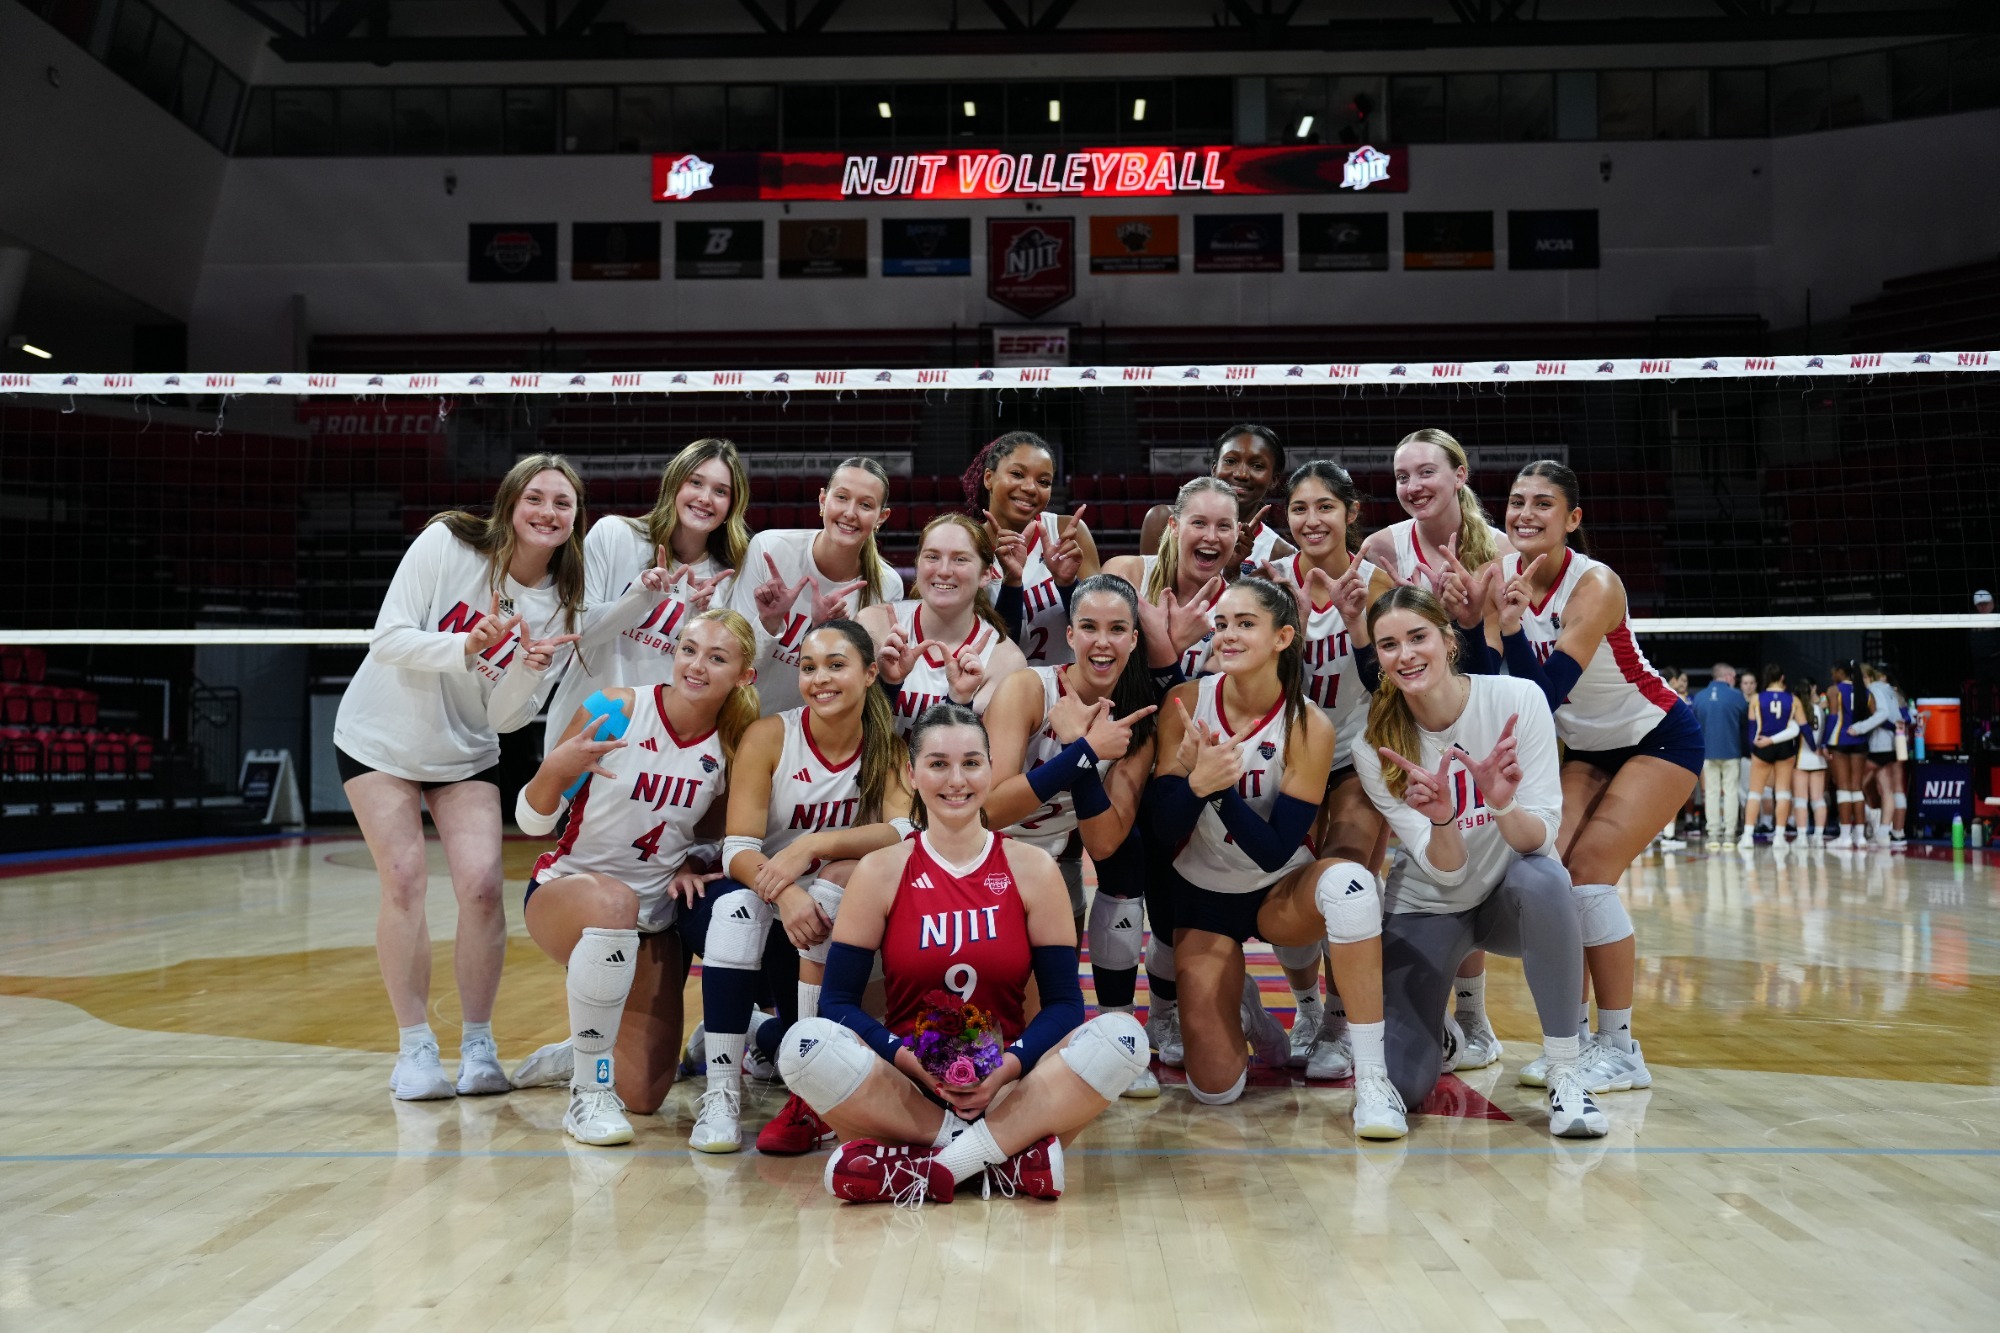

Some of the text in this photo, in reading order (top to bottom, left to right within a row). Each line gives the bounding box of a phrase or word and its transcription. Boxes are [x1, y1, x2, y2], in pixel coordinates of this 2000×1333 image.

[841, 152, 1225, 196] NJIT VOLLEYBALL
[1344, 160, 1389, 184] NJIT
[1008, 244, 1057, 278] NJIT
[1535, 238, 1574, 252] NCAA
[999, 336, 1066, 354] ESPN
[1, 352, 1989, 389] NJIT NJIT NJIT NJIT NJIT NJIT NJIT NJIT NJIT NJIT NJIT NJIT NJIT NJIT NJIT NJIT NJIT NJIT NJIT NJIT
[1023, 577, 1057, 625] JIT
[1026, 626, 1049, 661] 2
[1309, 673, 1341, 708] 11
[1769, 700, 1782, 720] 4
[630, 771, 703, 812] NJIT
[1924, 780, 1966, 798] NJIT
[788, 797, 860, 834] NJIT
[631, 820, 668, 862] 4
[919, 904, 1000, 957] NJIT
[943, 963, 978, 1003] 9
